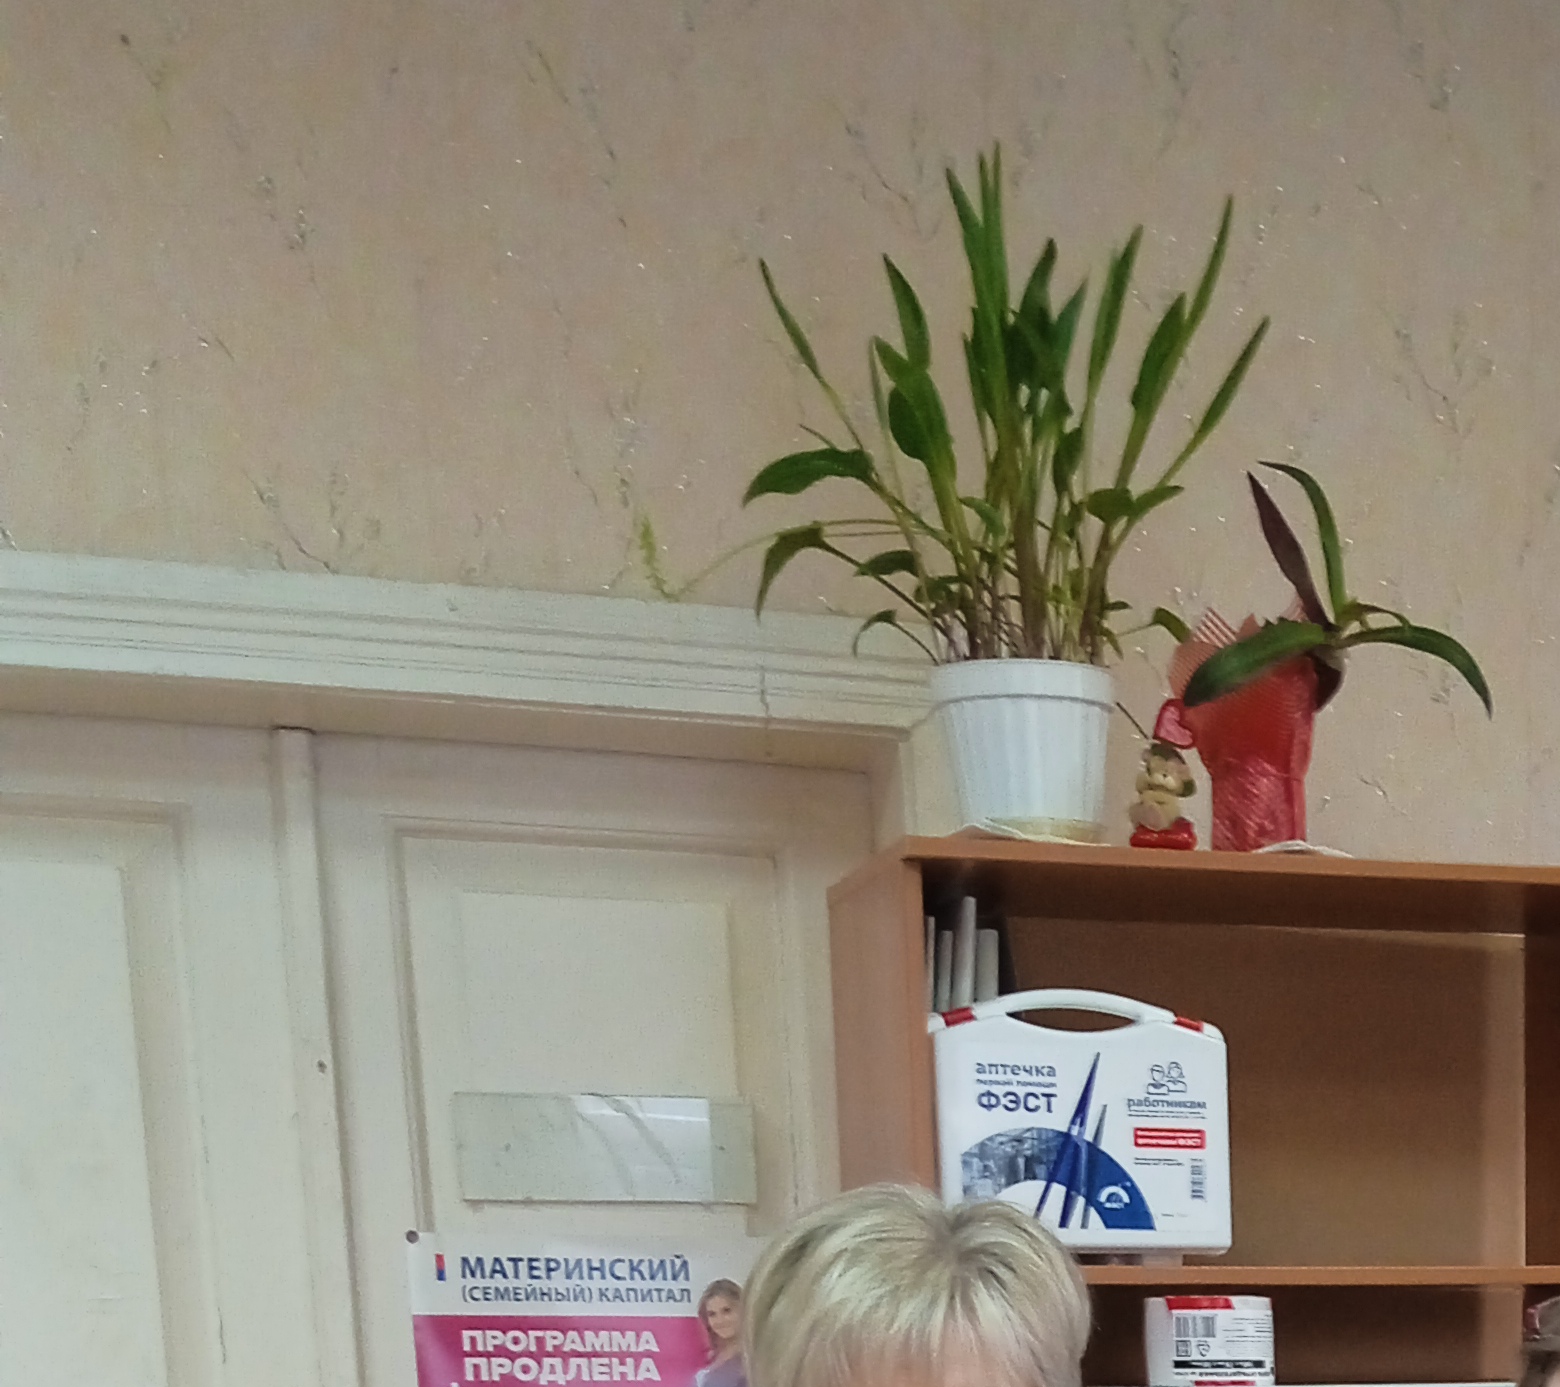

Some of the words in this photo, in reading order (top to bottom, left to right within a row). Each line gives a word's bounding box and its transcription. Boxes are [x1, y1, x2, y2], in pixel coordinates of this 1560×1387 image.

[976, 1062, 1056, 1077] аптечка
[977, 1090, 1058, 1113] ФЭСТ
[460, 1254, 690, 1282] МАТЕРИНСКИЙ
[461, 1284, 593, 1304] (СЕМЕЙНЫЙ)
[599, 1287, 691, 1303] КАПИТАЛ
[462, 1330, 660, 1352] ПРОГРАММА
[463, 1357, 661, 1385] ПРОДЛЕНА
